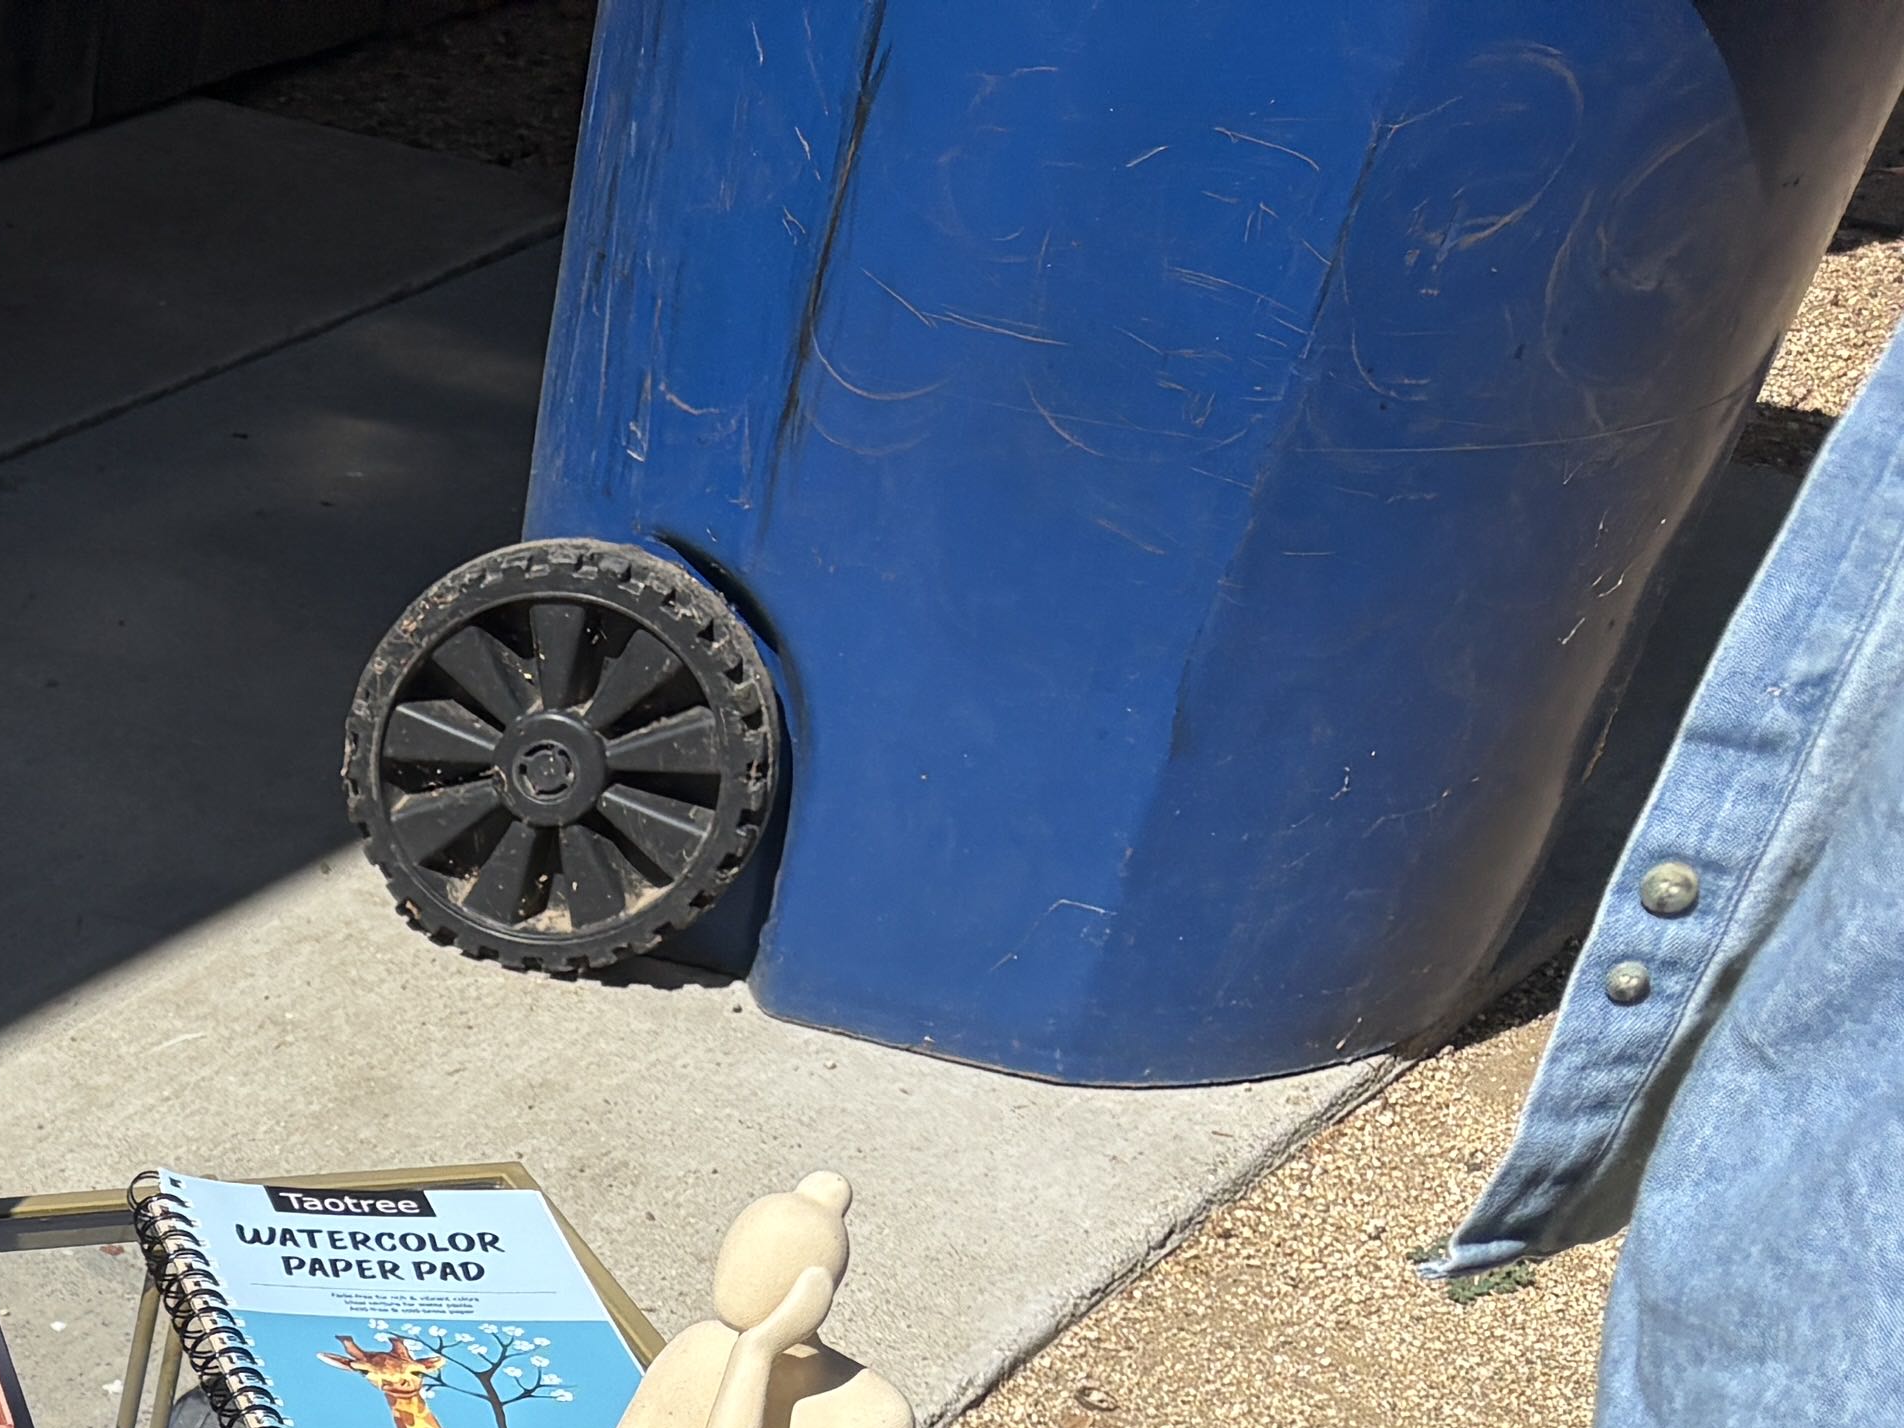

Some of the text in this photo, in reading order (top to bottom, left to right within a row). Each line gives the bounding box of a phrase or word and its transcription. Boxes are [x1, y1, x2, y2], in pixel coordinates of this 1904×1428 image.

[279, 1192, 420, 1213] Taotree
[235, 1223, 505, 1252] WATERCOLOR
[281, 1255, 485, 1281] PAPER PAD
